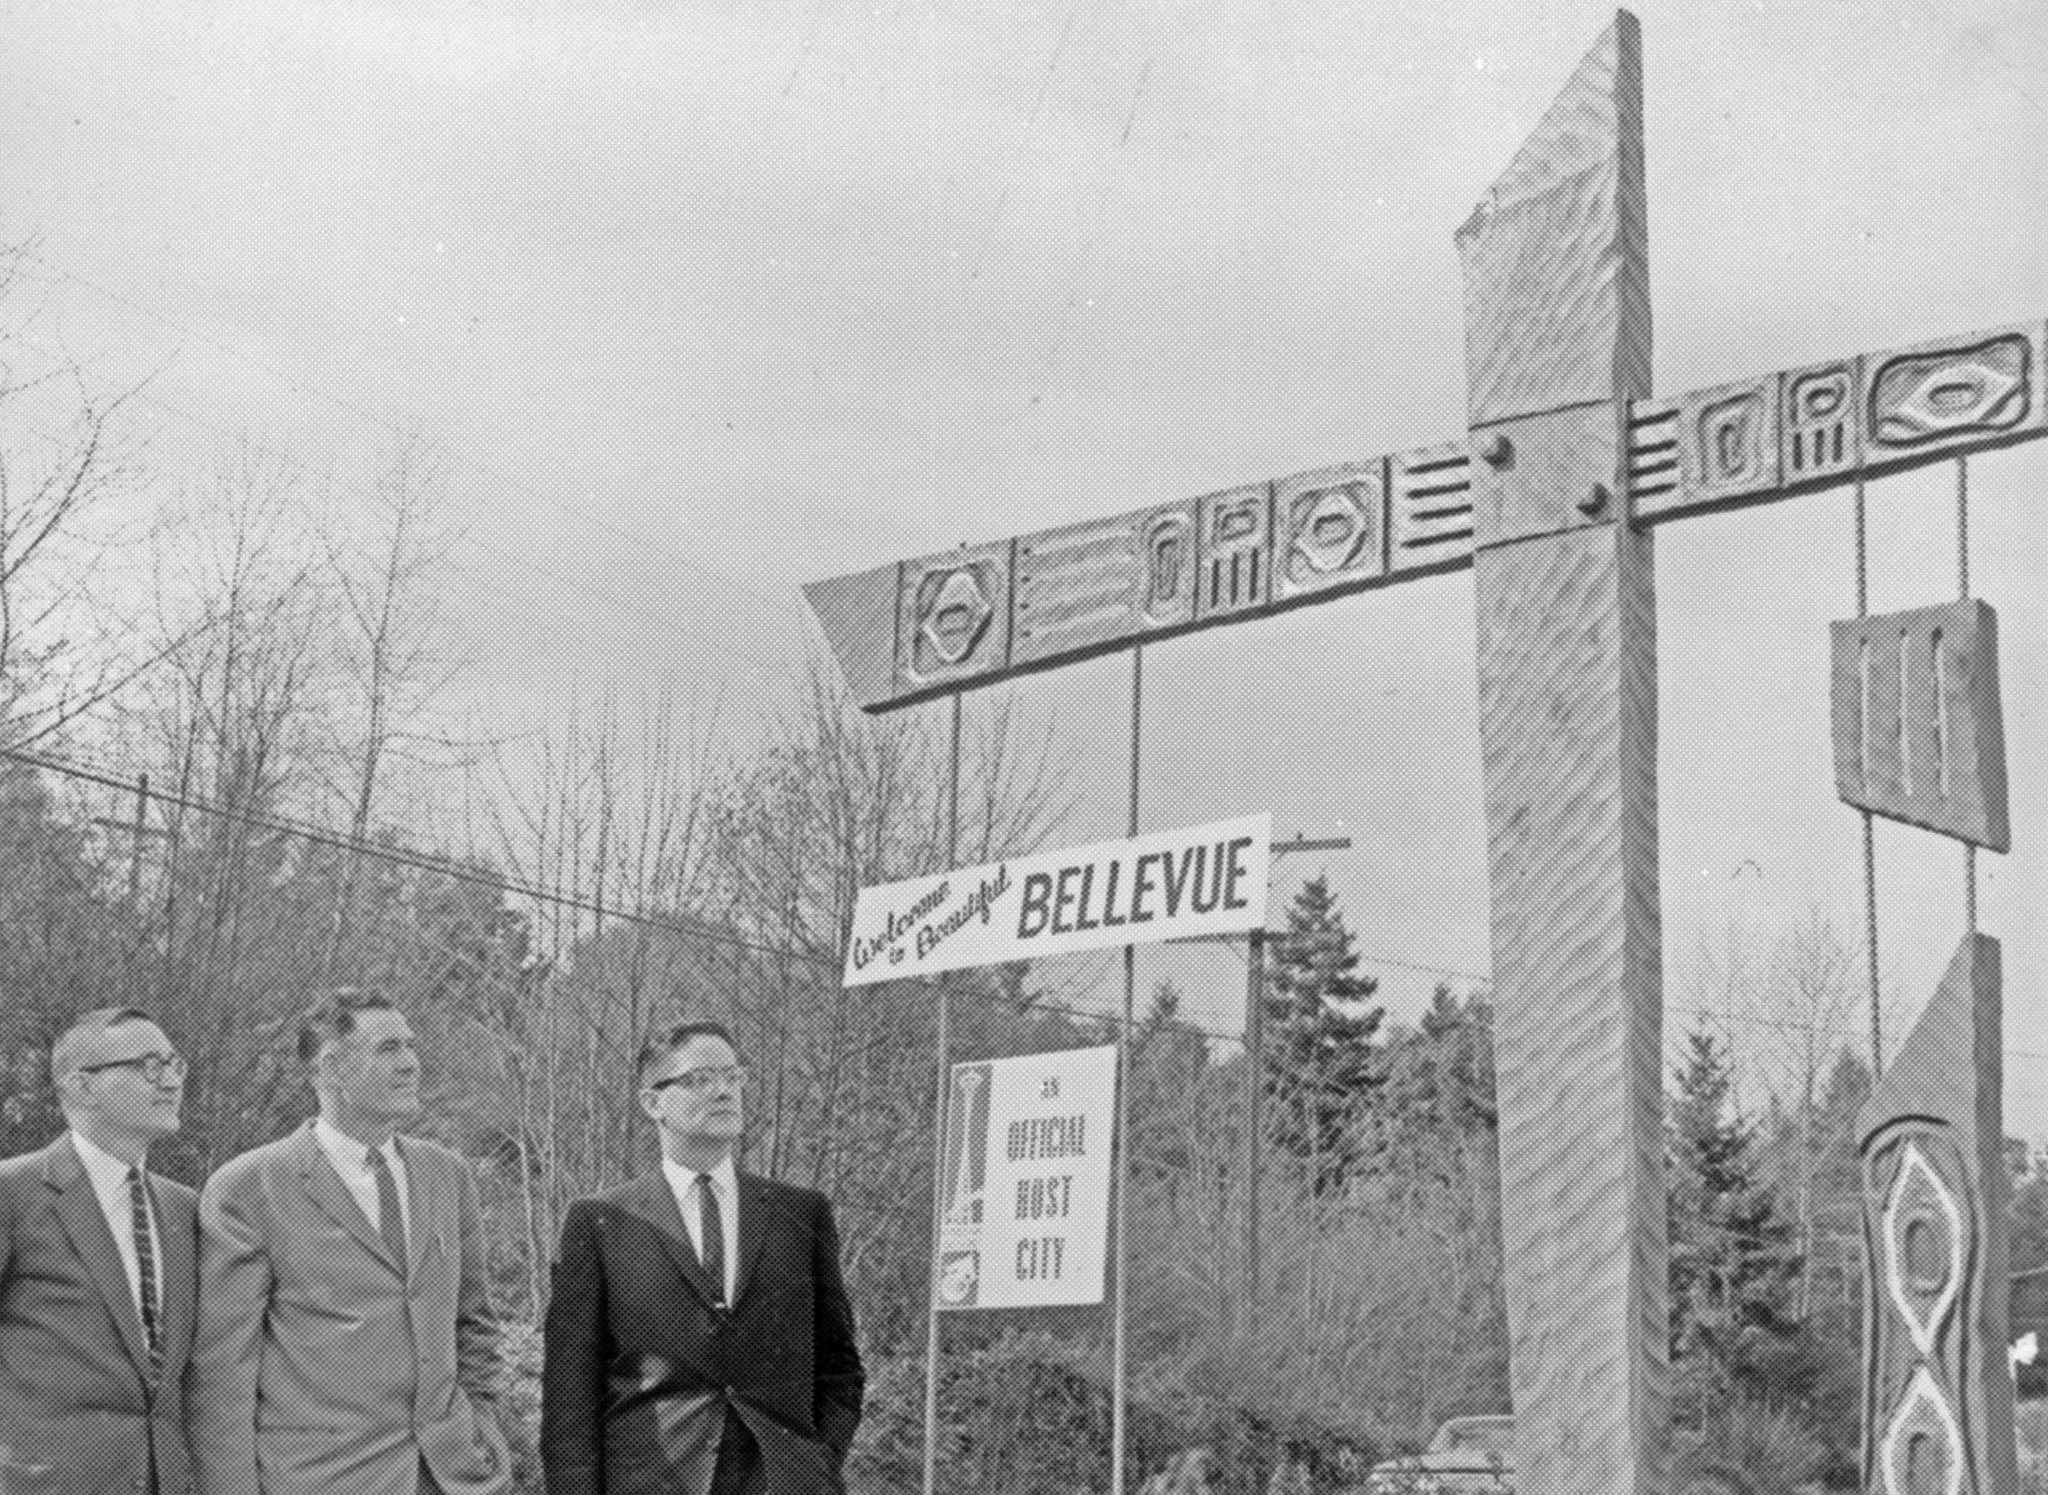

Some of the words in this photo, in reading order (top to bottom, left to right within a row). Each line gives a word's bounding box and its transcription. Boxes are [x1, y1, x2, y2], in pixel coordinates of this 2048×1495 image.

[917, 863, 1012, 960] Beautiful
[1017, 836, 1253, 940] BELLEVUE
[854, 881, 950, 970] Welcome
[1007, 1114, 1086, 1162] OFFICIAL
[1014, 1175, 1073, 1220] HOST
[1016, 1237, 1065, 1281] CITY
